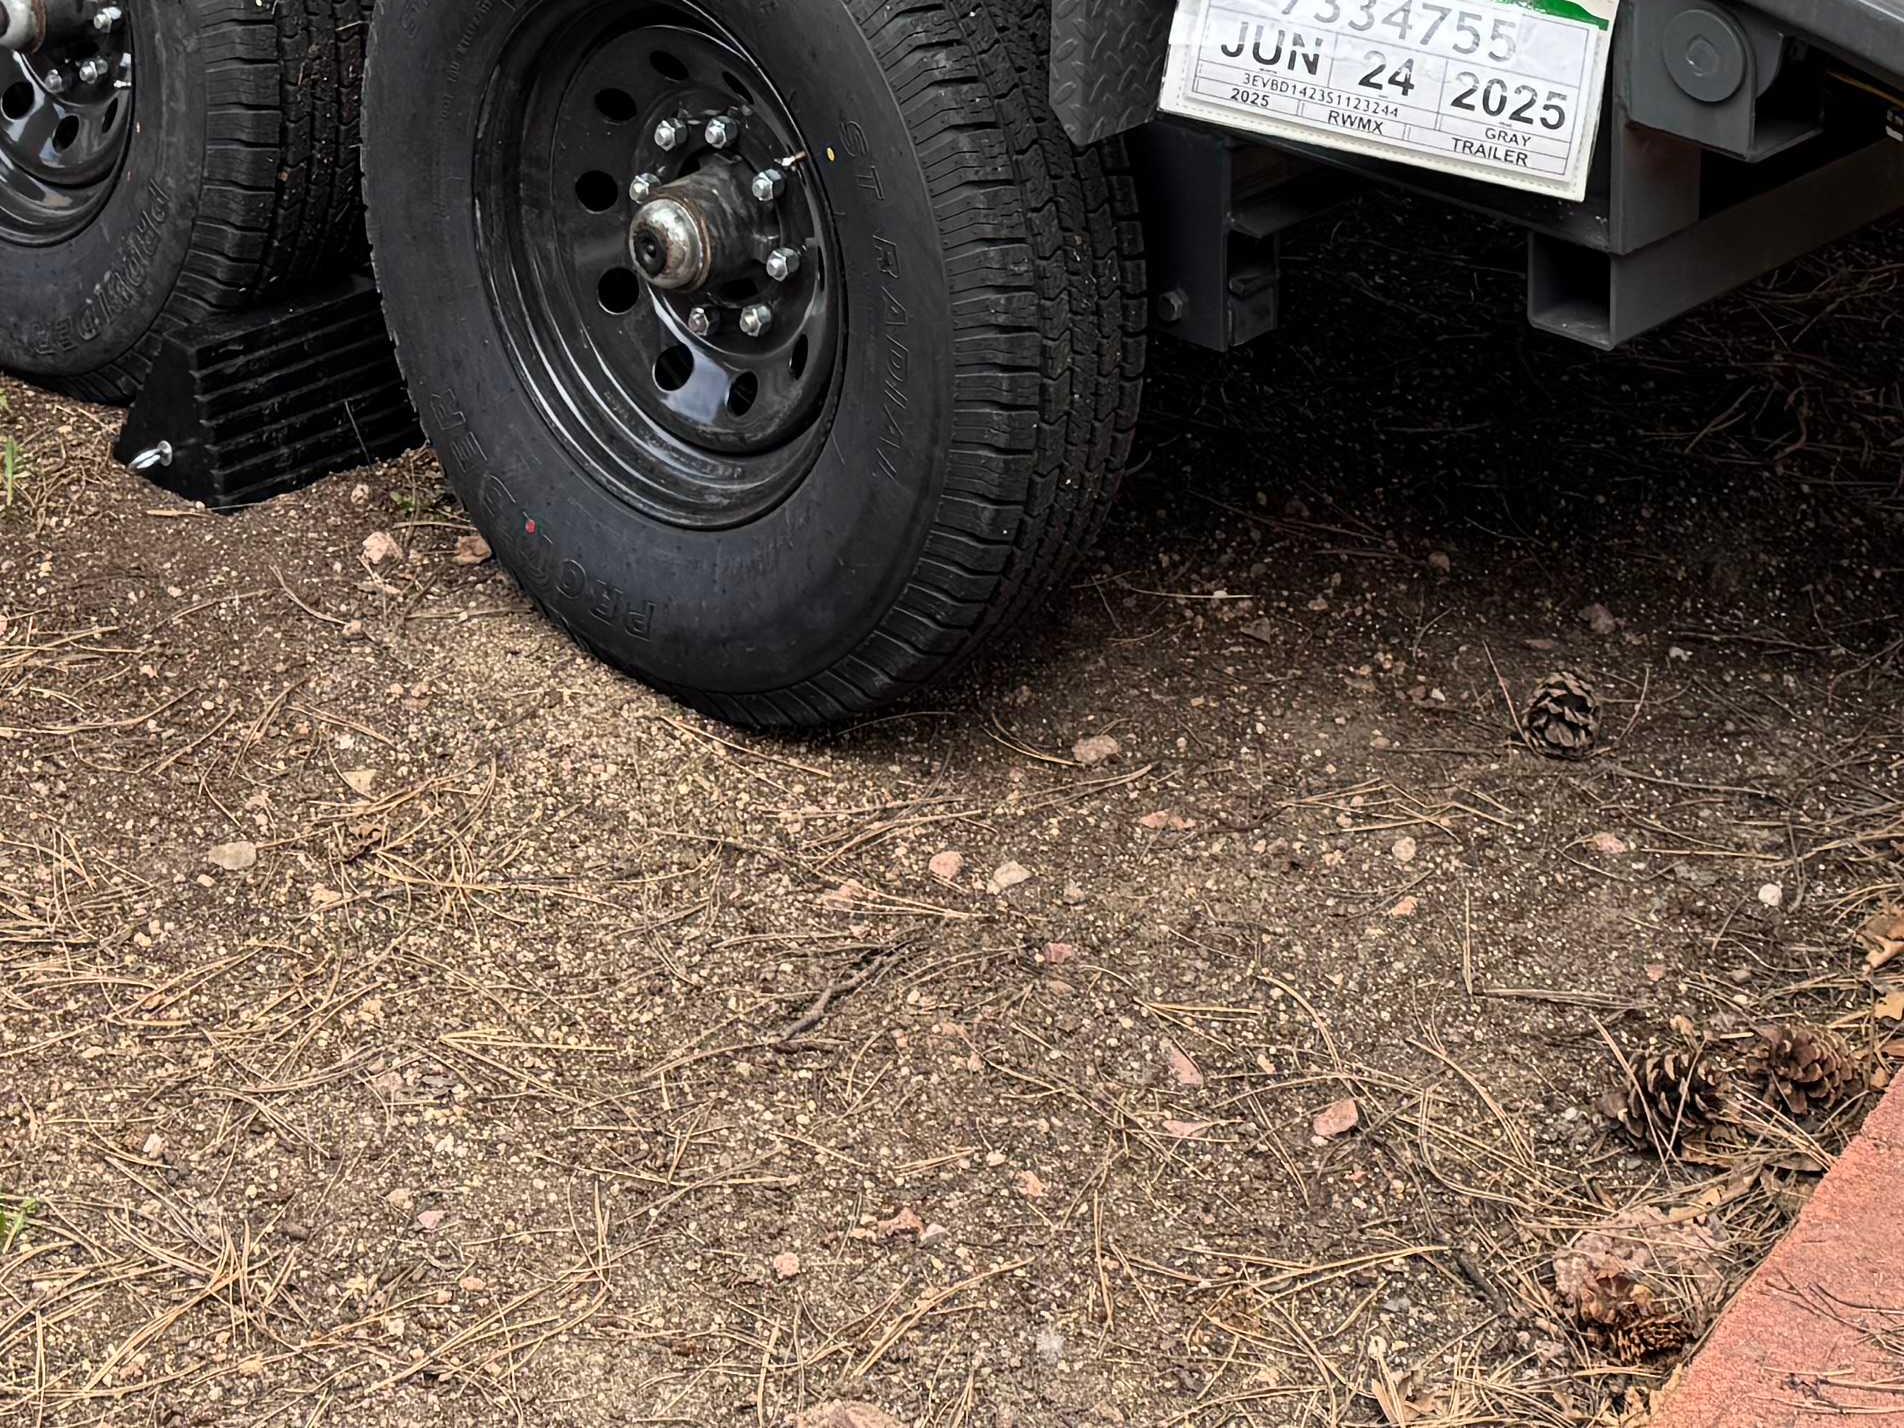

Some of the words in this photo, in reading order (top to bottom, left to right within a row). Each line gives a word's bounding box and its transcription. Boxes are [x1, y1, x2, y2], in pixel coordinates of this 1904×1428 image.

[1220, 21, 1324, 76] JUN
[1357, 49, 1415, 97] 24
[1450, 71, 1568, 130] 2025
[1230, 87, 1270, 108] 2025
[1327, 110, 1384, 135] RWMX
[1451, 137, 1528, 168] TRAILER
[1484, 127, 1532, 148] GRAY
